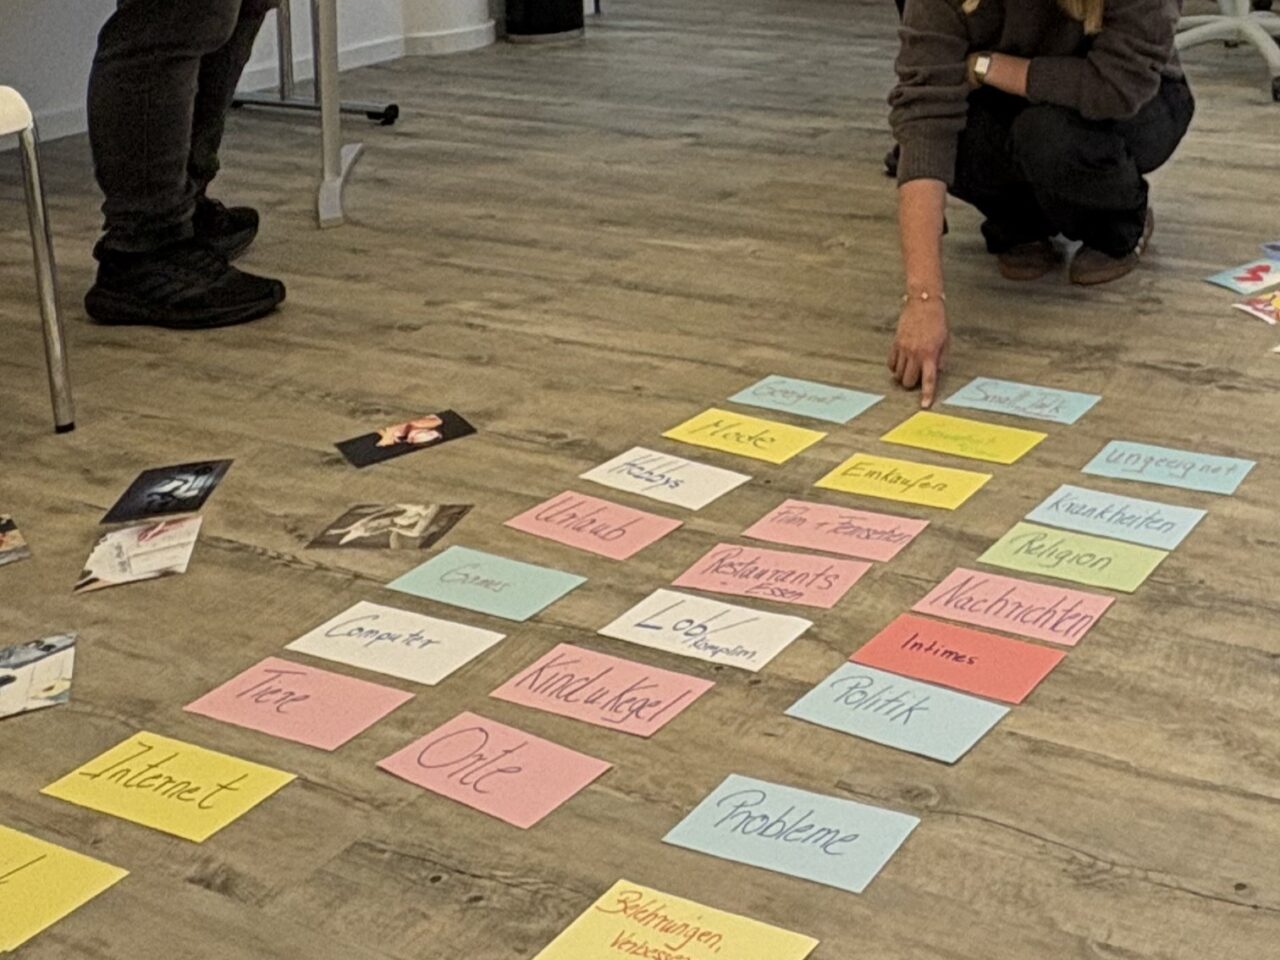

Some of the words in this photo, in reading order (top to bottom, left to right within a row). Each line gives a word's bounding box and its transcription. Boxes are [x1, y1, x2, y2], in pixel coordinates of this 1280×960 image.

[688, 413, 777, 449] Mode
[535, 495, 644, 542] Urlaub
[1048, 490, 1177, 535] Krankheiten
[702, 547, 841, 591] Restaurants
[1009, 529, 1113, 572] Religion
[322, 611, 447, 652] Computer
[934, 576, 1098, 640] Nachrichten
[901, 633, 978, 667] Intimes
[514, 652, 615, 703] Kind
[599, 676, 693, 724] Kegel
[829, 673, 931, 727] Politik
[78, 740, 250, 811] Internet
[416, 725, 530, 795] Orte
[715, 788, 861, 857] Probleme
